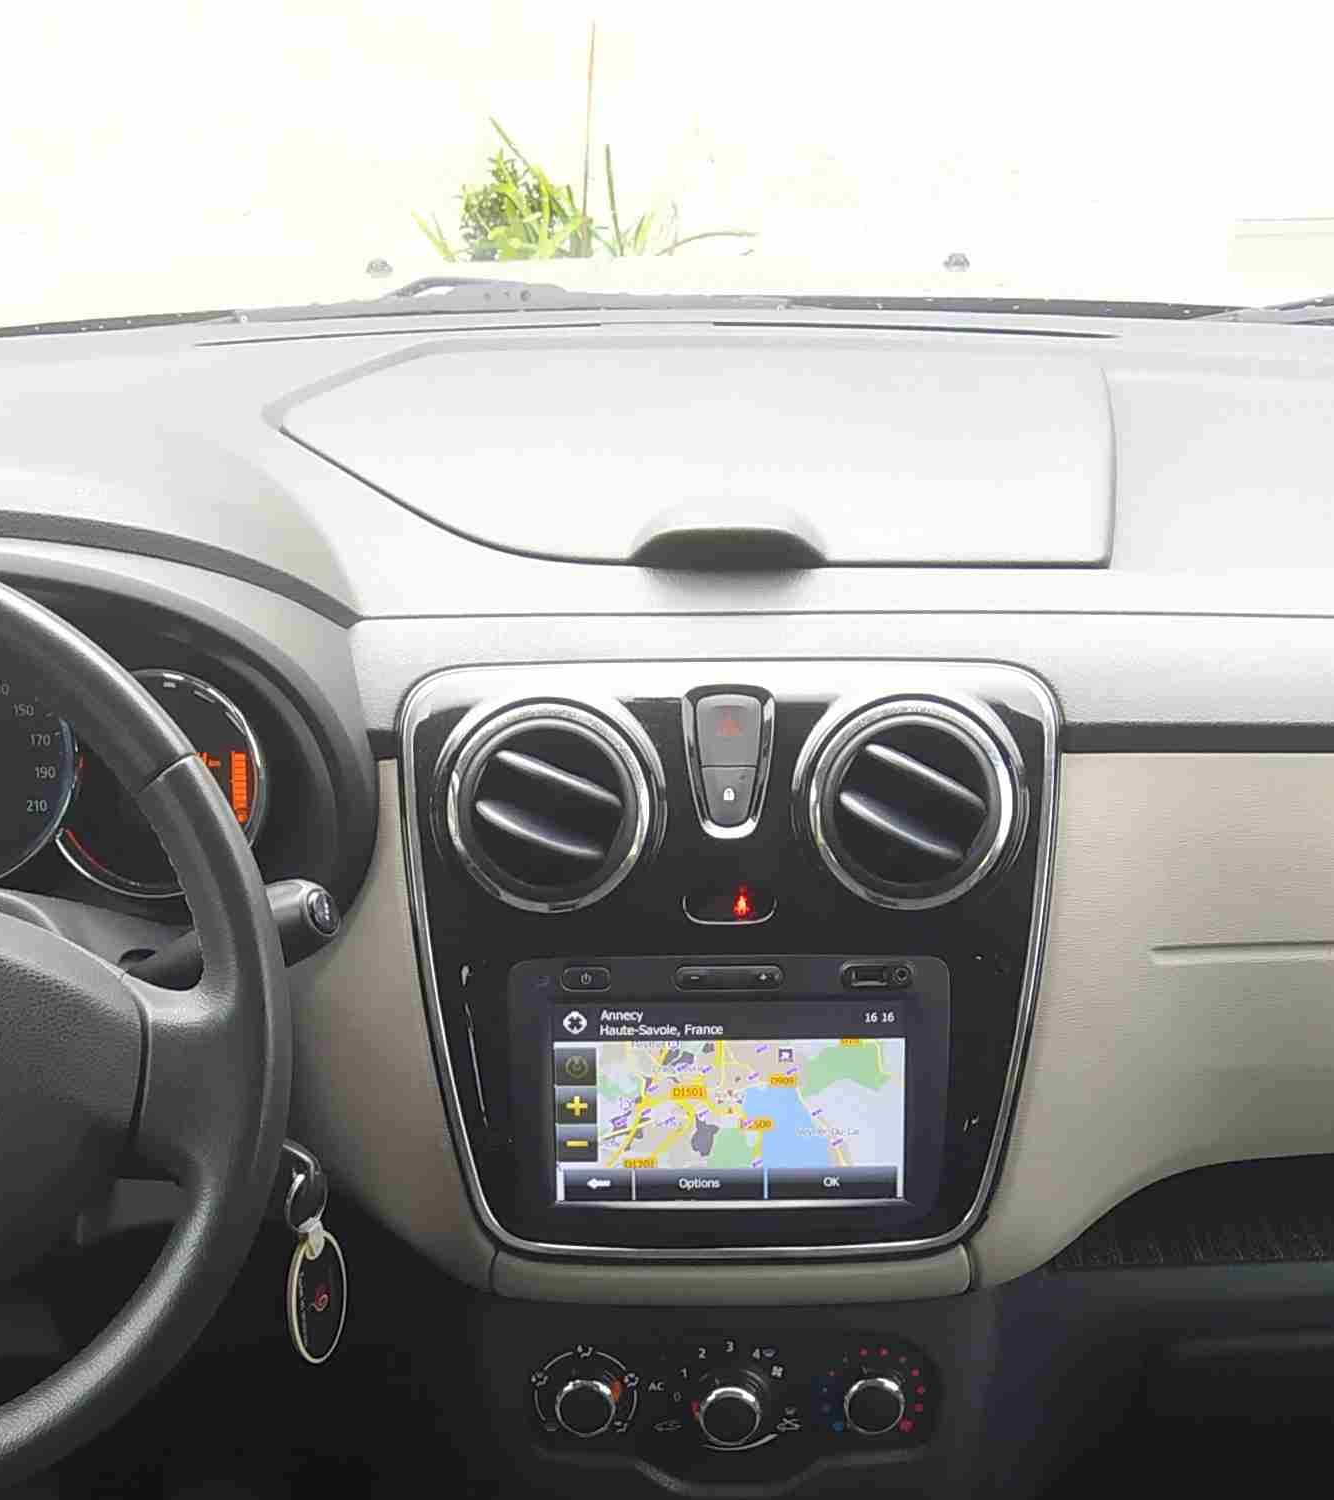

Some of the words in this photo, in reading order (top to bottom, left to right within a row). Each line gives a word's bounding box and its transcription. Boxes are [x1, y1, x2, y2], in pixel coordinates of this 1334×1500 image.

[13, 703, 35, 717] 150
[30, 733, 52, 746] 170
[34, 765, 56, 779] 190
[26, 799, 48, 813] 210
[600, 1009, 643, 1023] Annecy
[600, 1024, 681, 1036] Haute-Savoie,
[684, 1024, 724, 1035] France
[678, 1178, 721, 1190] Options
[823, 1176, 840, 1187] OK
[725, 1341, 734, 1352] 3
[698, 1348, 707, 1359] 2
[752, 1348, 762, 1359] 4
